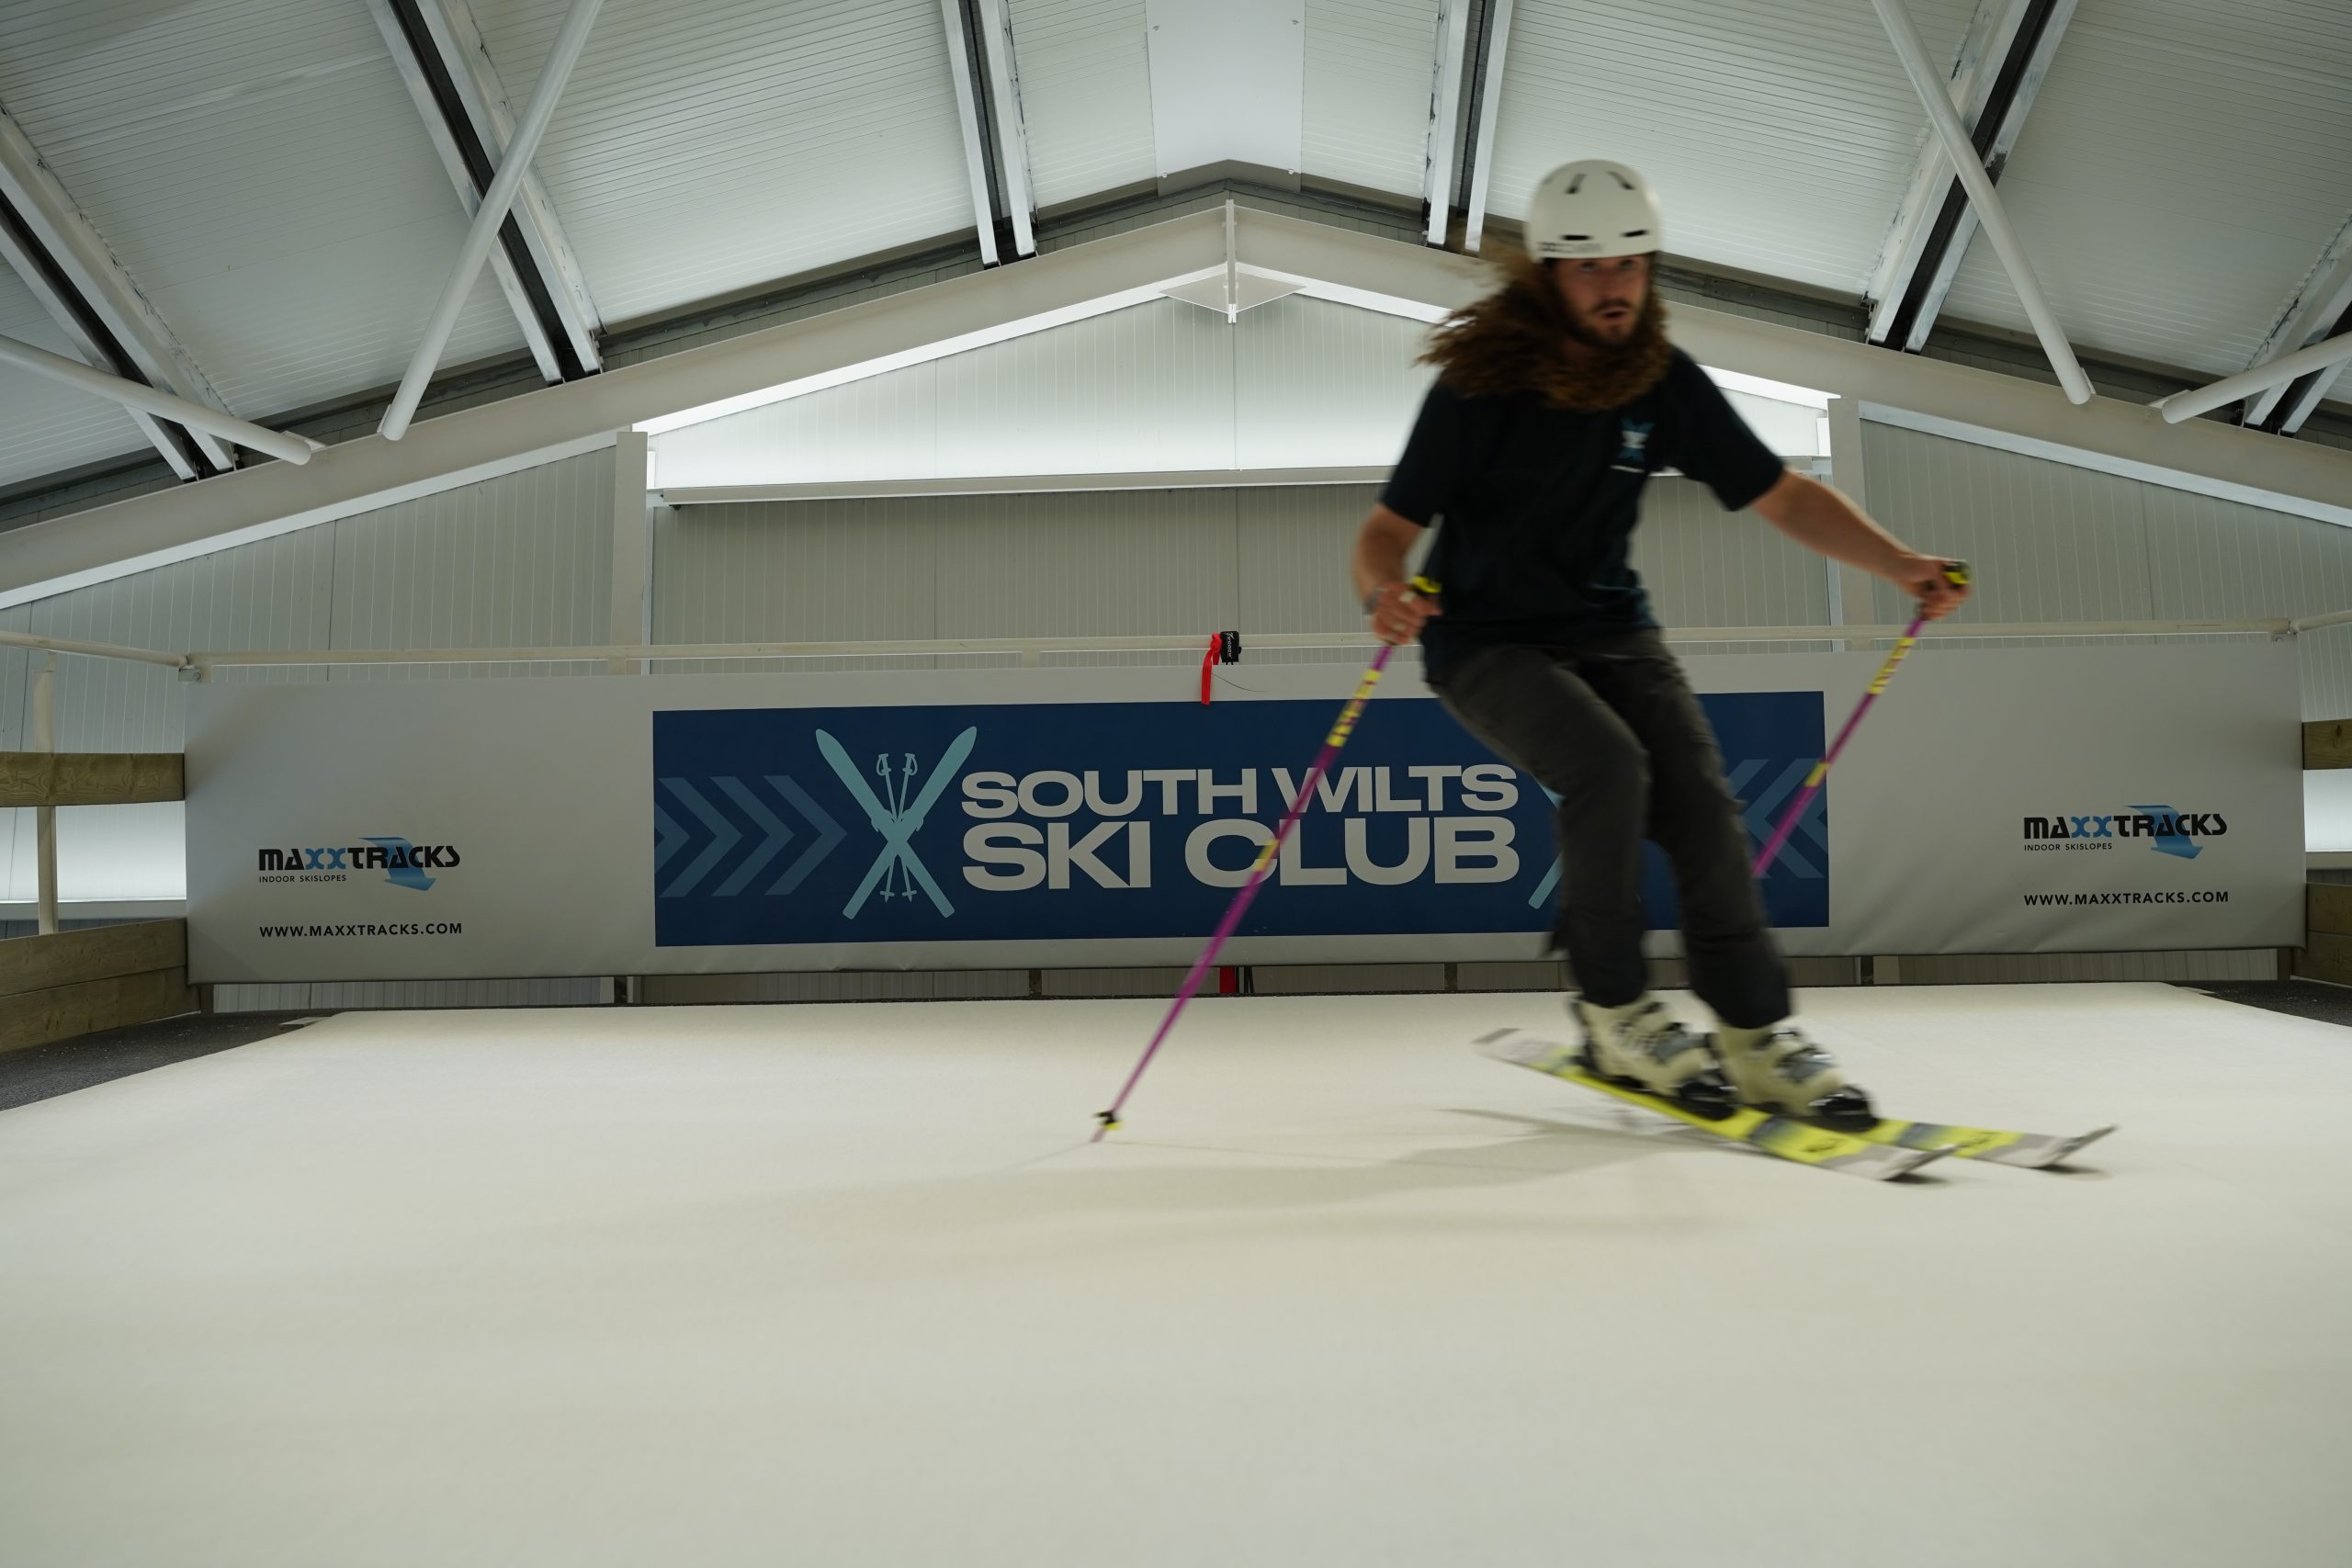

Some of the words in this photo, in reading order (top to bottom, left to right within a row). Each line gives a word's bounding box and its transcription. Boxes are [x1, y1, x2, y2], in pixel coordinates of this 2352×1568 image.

[961, 769, 1257, 818] SOUTH
[1272, 764, 1519, 813] WILTS
[2024, 814, 2227, 839] MAXXTRACKS
[962, 820, 1151, 891] SKI
[1184, 816, 1520, 888] CLUB
[2024, 843, 2060, 852] INDOOR
[2064, 842, 2112, 851] SKISLOPES
[258, 845, 460, 870] MAXXTRACKS
[258, 875, 295, 884] INDOOR
[300, 874, 346, 883] SKISLOPES
[2024, 891, 2229, 906] WWW.MAXXTRACKS.COM
[259, 922, 462, 937] WWW.MAXXTRACKS.COM
